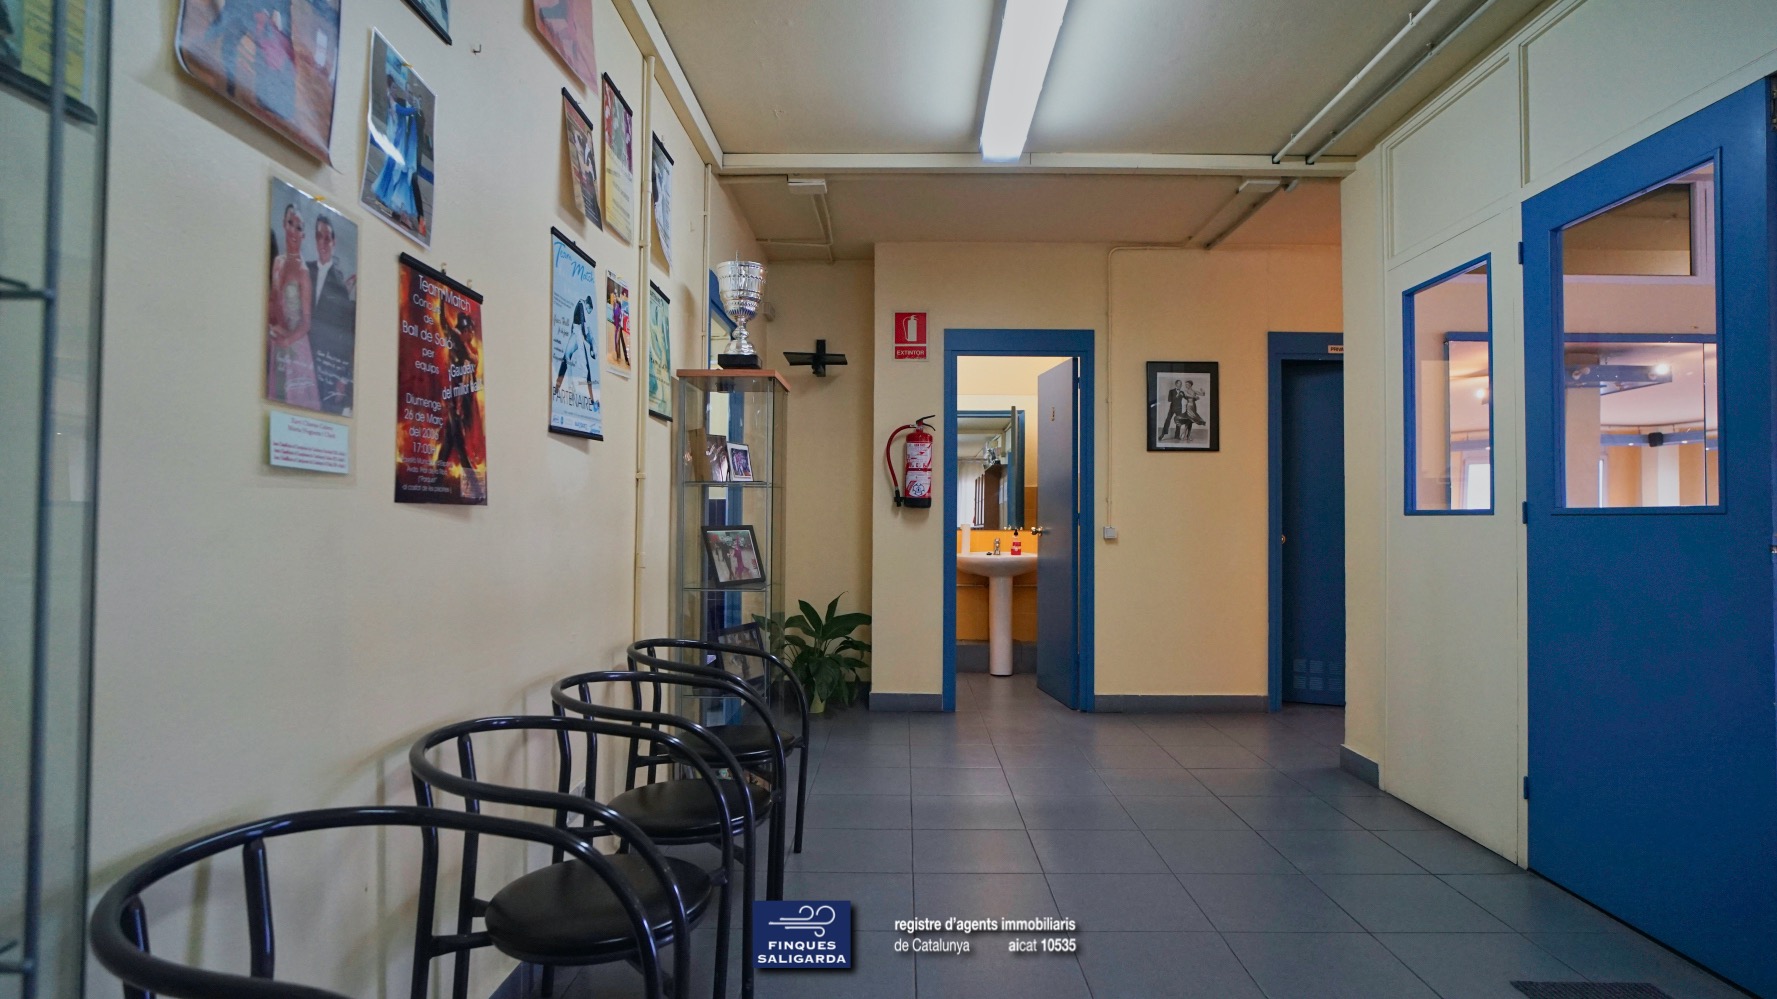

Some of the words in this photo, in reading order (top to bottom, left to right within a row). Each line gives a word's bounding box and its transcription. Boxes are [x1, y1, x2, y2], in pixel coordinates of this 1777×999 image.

[554, 241, 573, 268] Team
[418, 275, 446, 299] Team
[445, 289, 471, 313] Match
[423, 315, 434, 325] de
[402, 320, 419, 338] Ball
[420, 329, 433, 343] de
[434, 333, 453, 350] Saló
[421, 347, 435, 359] per
[414, 360, 440, 375] equips
[405, 392, 442, 411] Diumenge
[441, 385, 453, 400] del
[552, 386, 593, 412] PARTENAIRE
[404, 408, 414, 421] 26
[415, 411, 426, 423] de
[426, 413, 444, 429] Març
[409, 426, 421, 438] del
